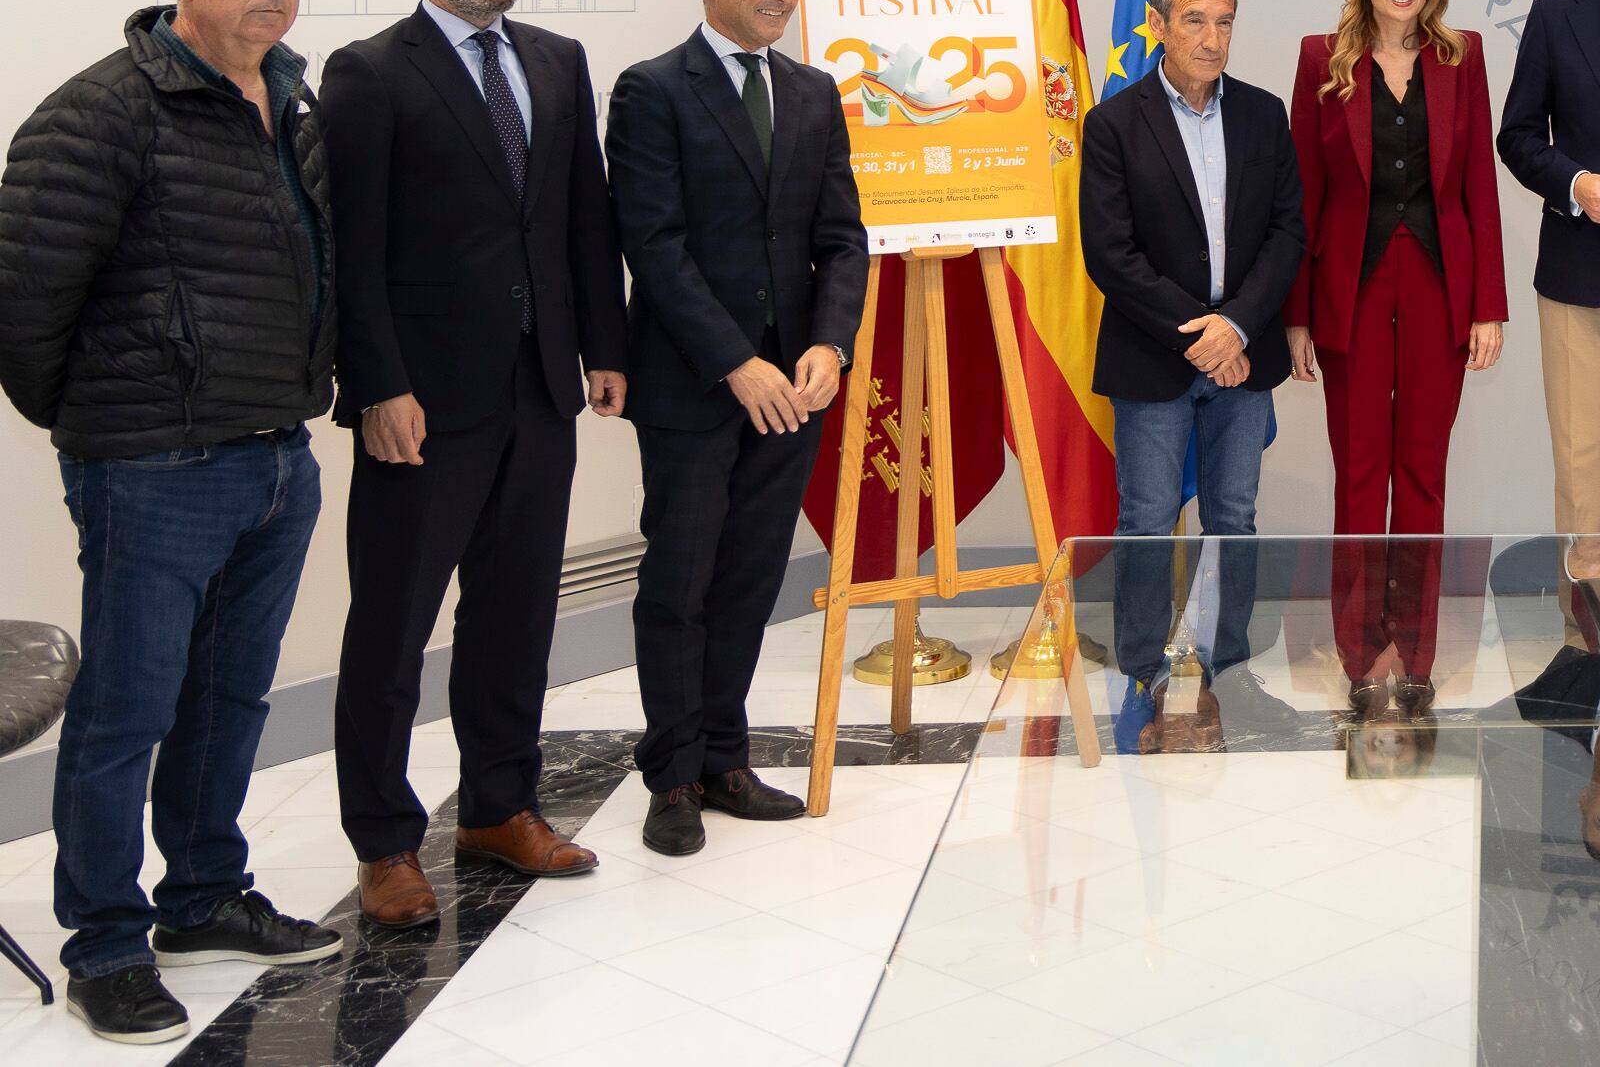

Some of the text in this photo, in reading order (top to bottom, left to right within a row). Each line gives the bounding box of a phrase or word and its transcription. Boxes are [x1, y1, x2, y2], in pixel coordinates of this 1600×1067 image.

[862, 161, 881, 174] 30,
[909, 160, 916, 170] 1
[963, 155, 1026, 171] 2 y 3 Junio
